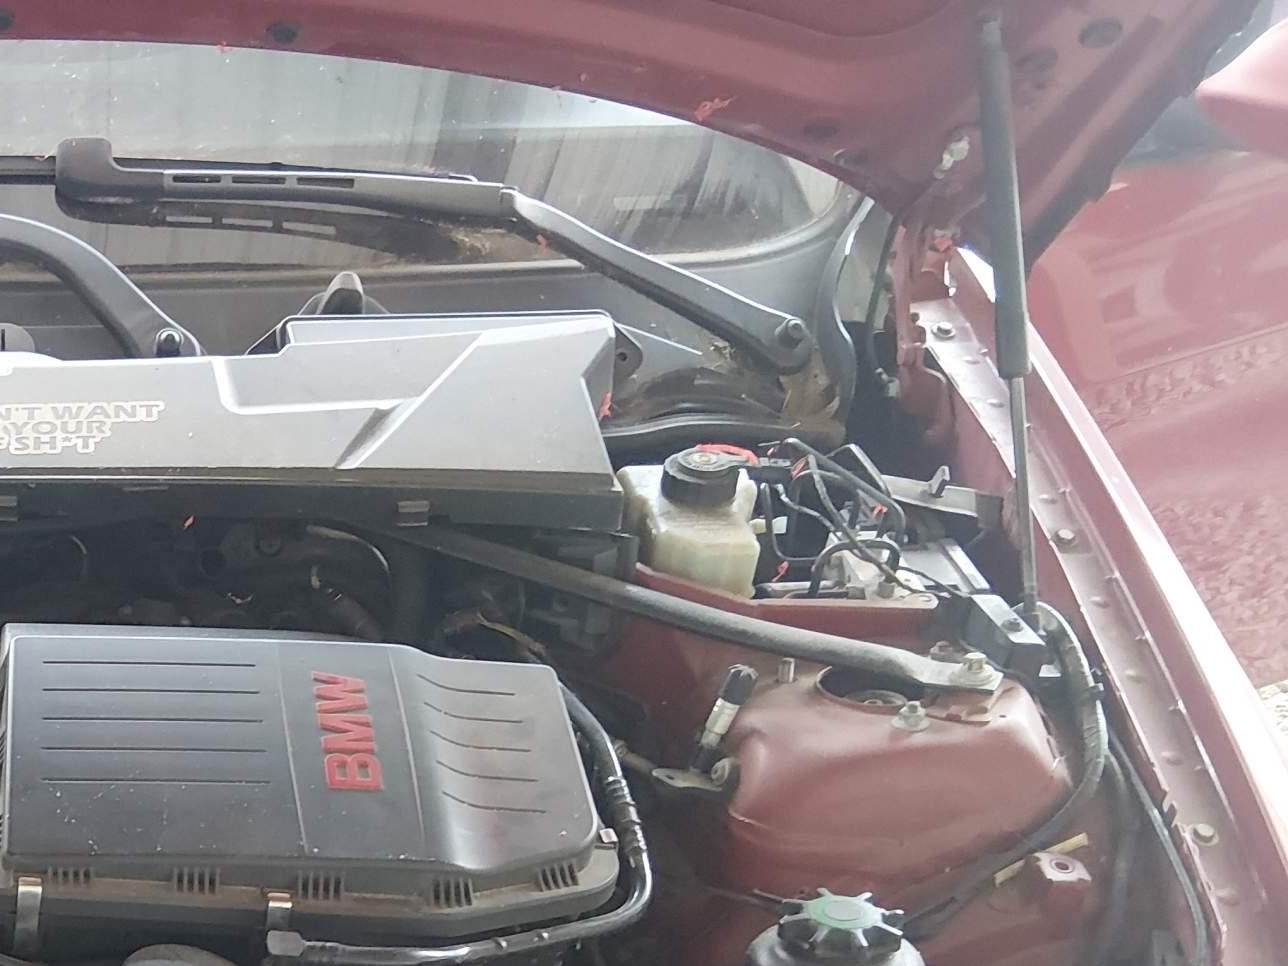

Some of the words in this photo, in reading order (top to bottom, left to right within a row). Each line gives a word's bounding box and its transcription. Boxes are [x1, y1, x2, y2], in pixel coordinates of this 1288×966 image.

[50, 403, 161, 420] WANT
[9, 418, 106, 435] YOUR
[311, 670, 384, 791] BMW
